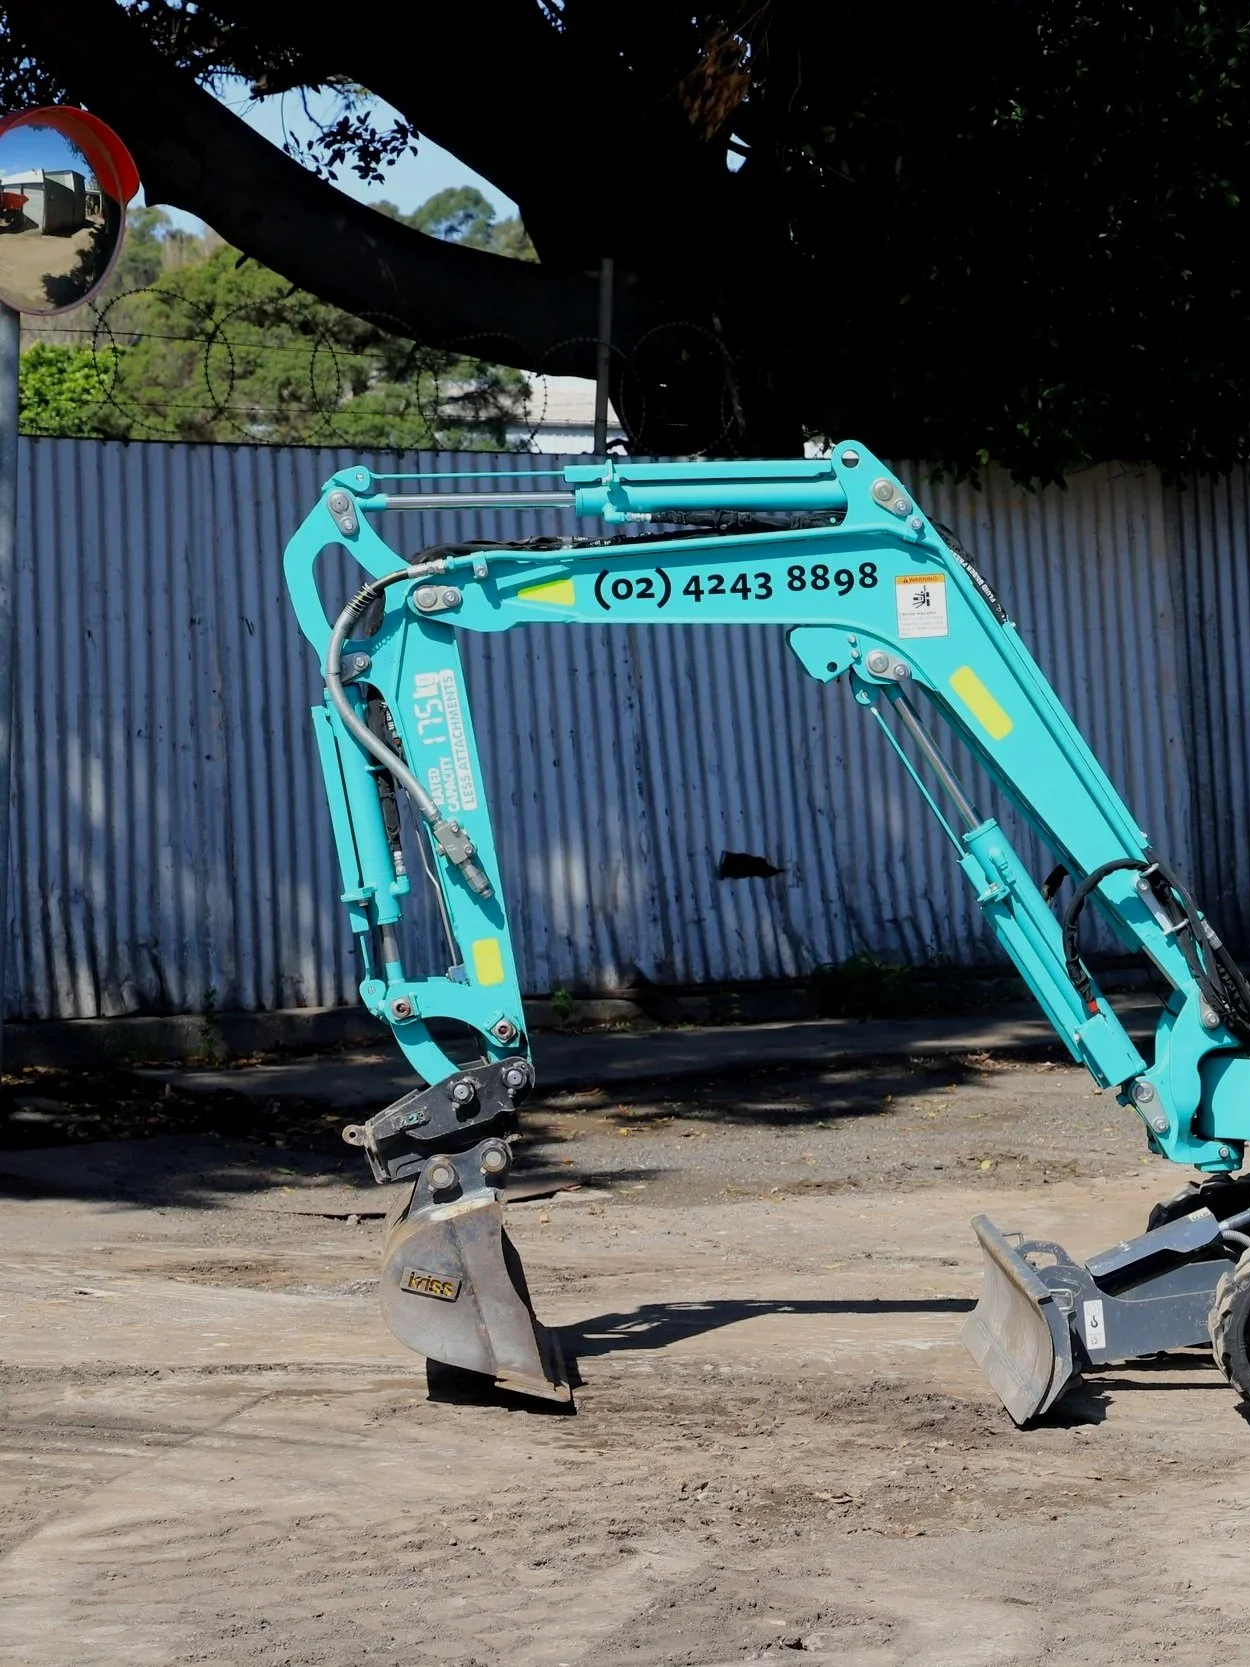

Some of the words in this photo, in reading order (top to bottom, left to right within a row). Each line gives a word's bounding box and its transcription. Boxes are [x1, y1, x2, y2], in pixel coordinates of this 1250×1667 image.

[593, 566, 672, 611] (02)
[682, 572, 774, 603] 4243
[786, 561, 879, 597] 8898
[443, 675, 470, 771] ATTACHMENTS
[428, 767, 445, 806] RATED
[439, 756, 461, 813] CAPACITY
[462, 773, 475, 804] LESS
[407, 1271, 454, 1297] kriss
